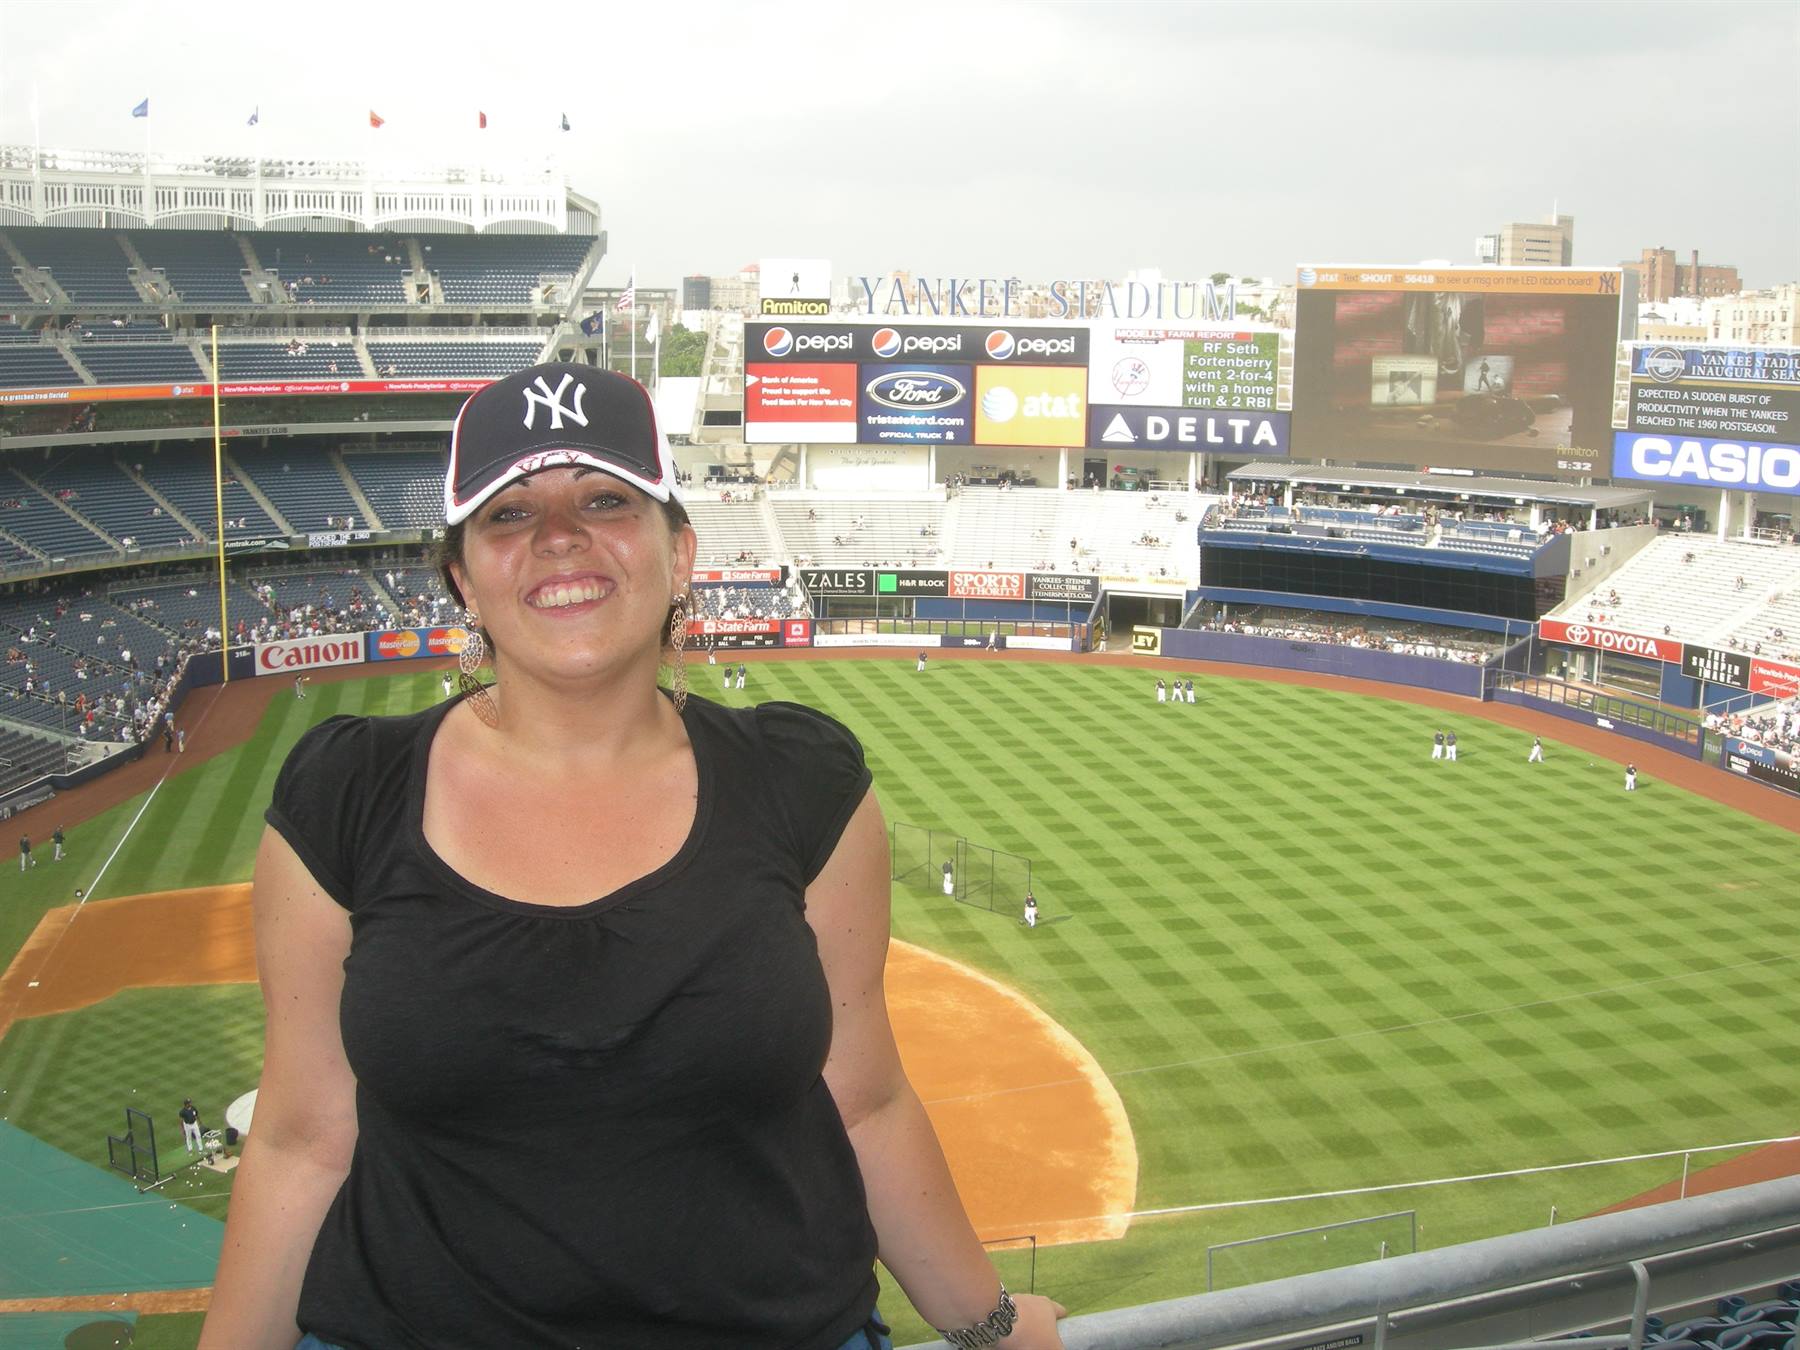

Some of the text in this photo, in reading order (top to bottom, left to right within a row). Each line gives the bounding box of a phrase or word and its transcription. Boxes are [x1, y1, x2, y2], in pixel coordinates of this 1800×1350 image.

[1359, 273, 1393, 284] SHOUT
[1506, 276, 1521, 285] the
[1521, 276, 1537, 286] LED
[1539, 276, 1567, 286] ribbon
[860, 276, 1237, 322] YANKEE STADIUM
[762, 299, 828, 315] Armitron
[795, 332, 853, 352] pepsi
[1168, 330, 1195, 339] FARM
[1197, 331, 1236, 340] REPORT
[903, 333, 962, 354] pepsi
[1017, 336, 1076, 357] pepsi
[1203, 342, 1260, 355] RF Seth
[1189, 355, 1273, 371] Fortenberry
[1702, 354, 1752, 368] YANKEE
[1187, 369, 1274, 381] went 2-for-4
[1691, 365, 1769, 379] INAUGURAL
[818, 387, 831, 395] the
[889, 378, 942, 403] Ford
[1185, 382, 1275, 396] with a home
[522, 373, 589, 430] NY
[1187, 395, 1271, 409] run & 2 RBI
[1638, 389, 1772, 405] EXPECTED A SUDDEN BURST OF
[1637, 403, 1788, 421] PRODUCTIVITY WHEN THE YANKEES
[866, 415, 964, 426] tristateford.com
[1636, 416, 1777, 434] REACHED THE 1960 POSTSEASON.
[242, 427, 270, 435] YANKEES
[879, 431, 914, 439] OFFICIAL
[915, 432, 942, 440] TRUCK
[1146, 415, 1278, 446] DELTA
[1557, 443, 1599, 458] Armitron
[1557, 460, 1592, 471] 5:32
[1631, 437, 1800, 488] CASIO
[225, 539, 266, 548] Amtrak.com
[339, 533, 350, 541] THE
[354, 532, 370, 540] 1960
[808, 573, 866, 588] ZALES
[899, 579, 945, 587] H&R BLOCK
[953, 573, 1020, 588] SPORTS
[1039, 583, 1085, 591] COLLECTIBLES
[954, 586, 1019, 597] AUTHORITY
[1031, 591, 1092, 599] STEINERSPORTS.COM
[379, 638, 420, 649] MasterCard
[1592, 628, 1659, 657] TOYOTA
[260, 638, 360, 670] Canon
[1707, 649, 1727, 663] THE
[1691, 655, 1741, 677] SHARPER
[1698, 666, 1733, 684] IMAGE
